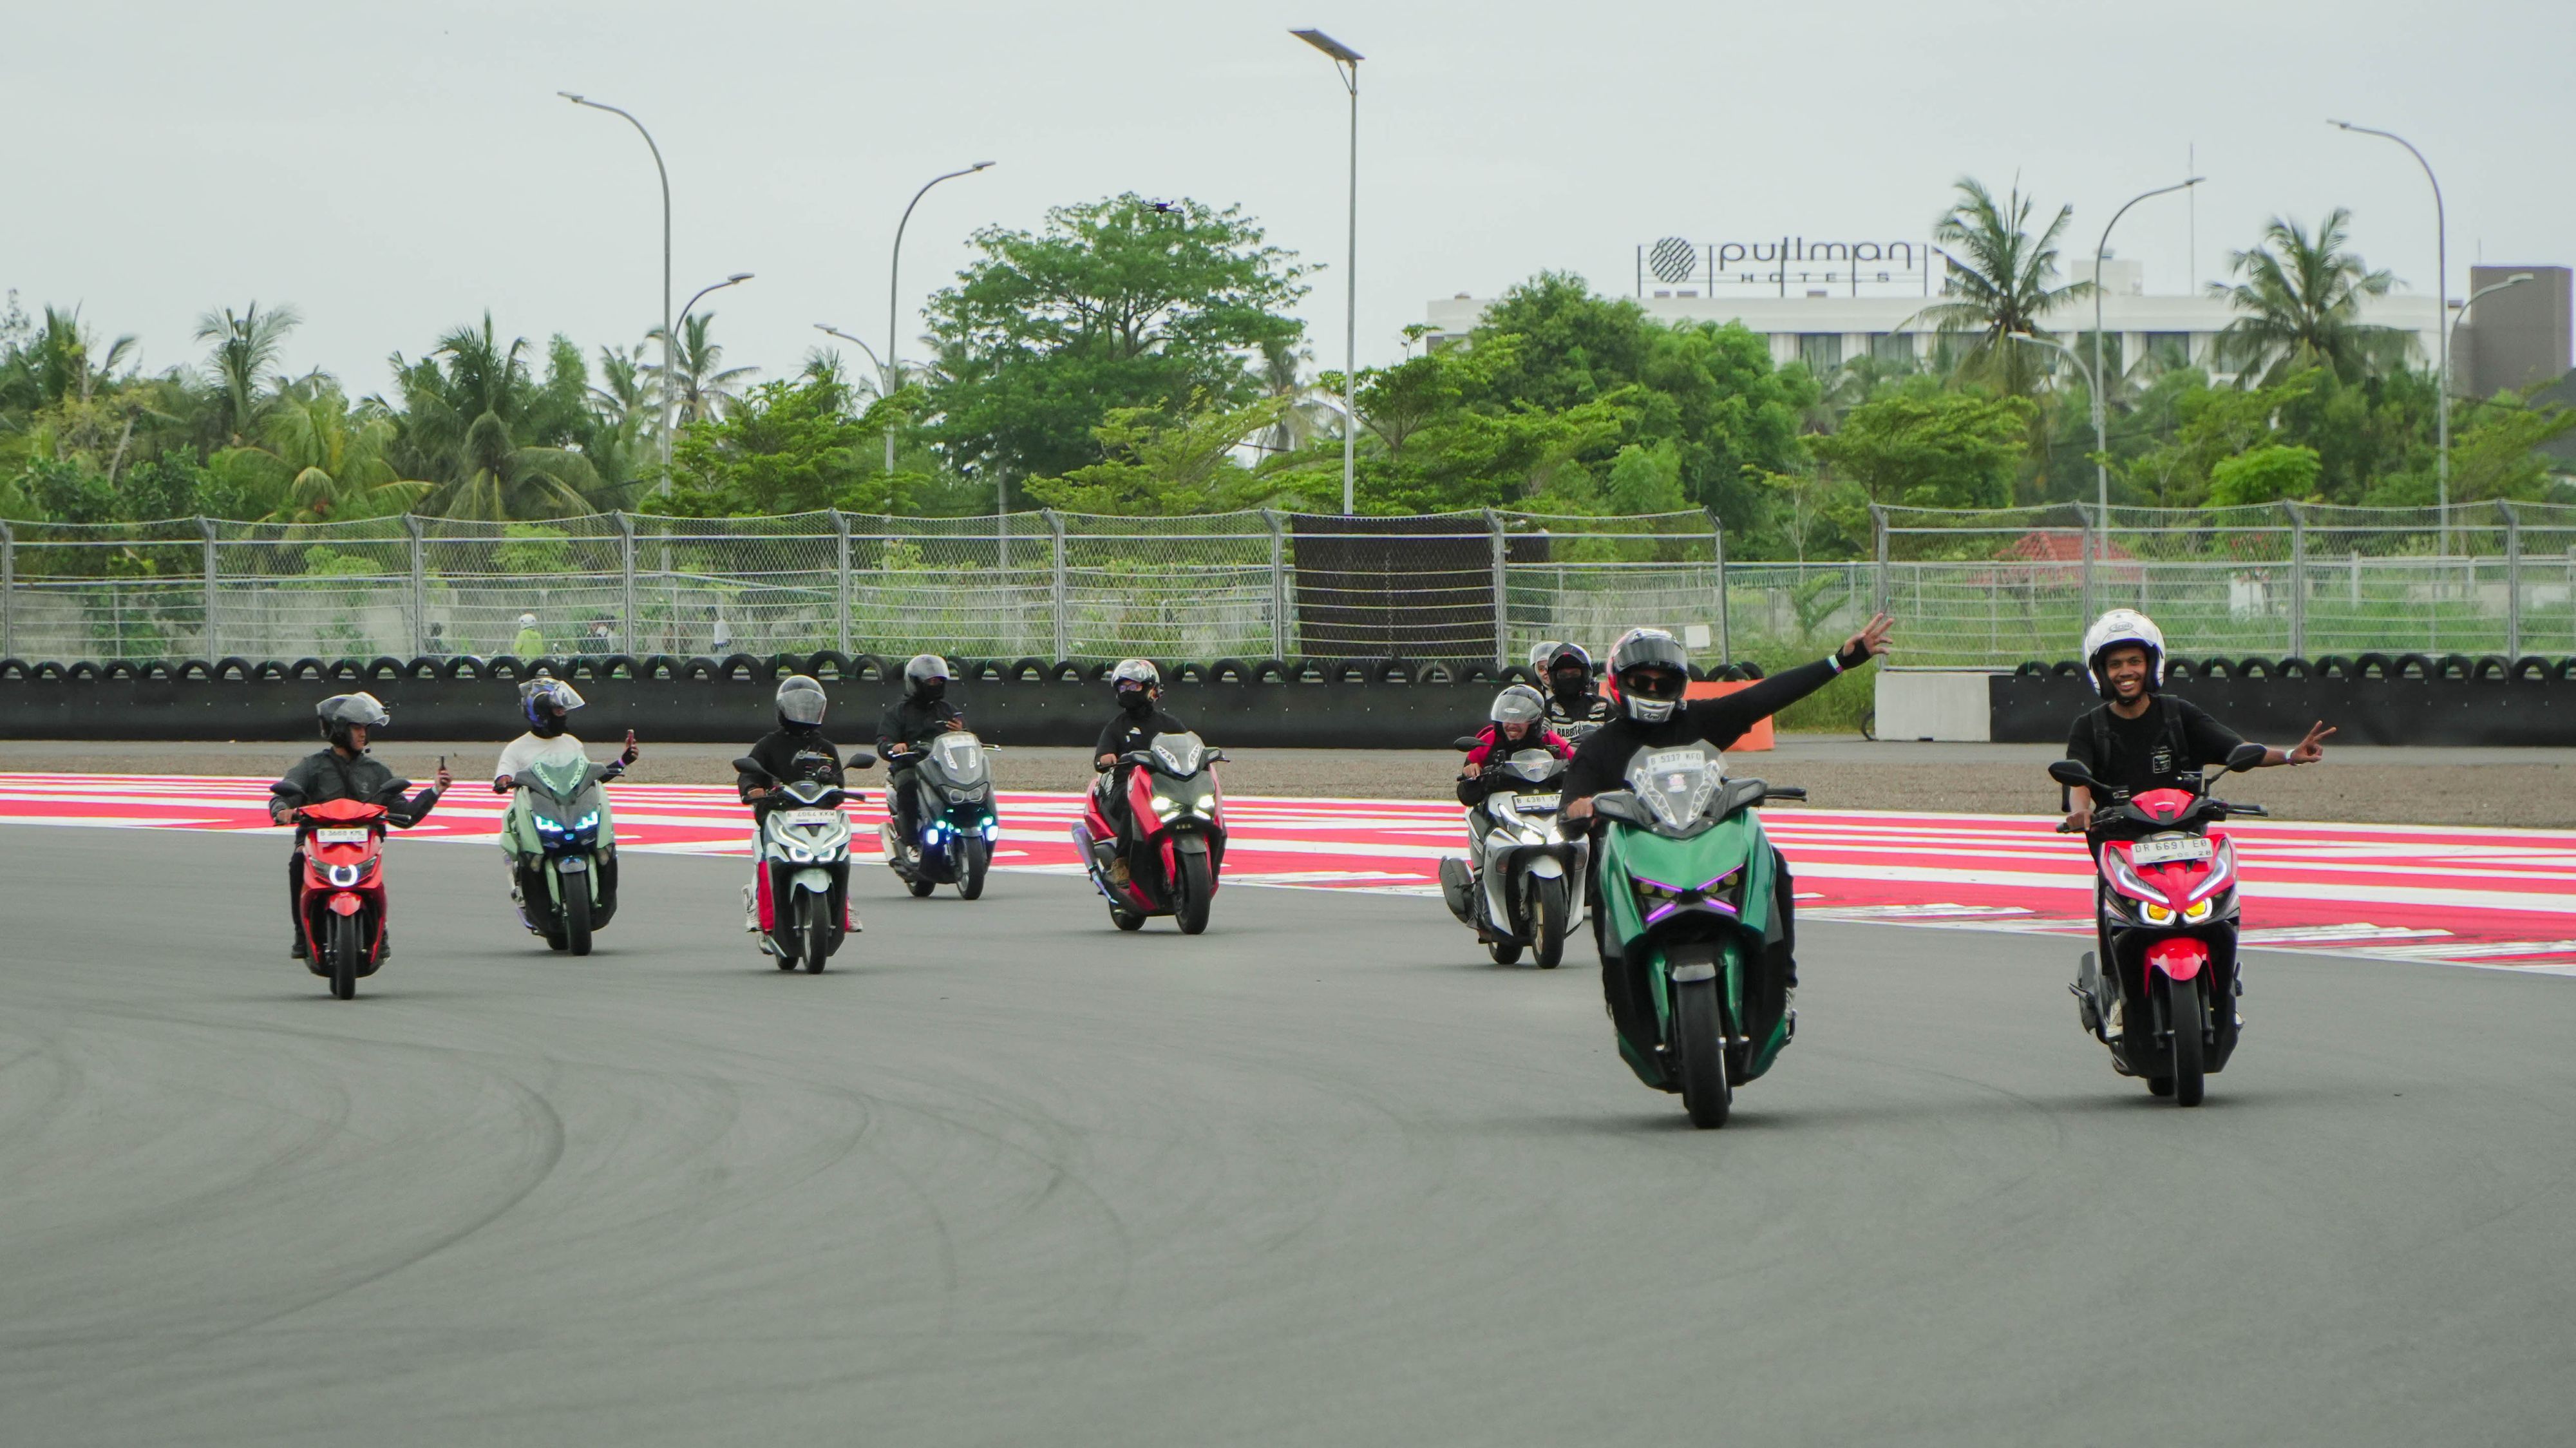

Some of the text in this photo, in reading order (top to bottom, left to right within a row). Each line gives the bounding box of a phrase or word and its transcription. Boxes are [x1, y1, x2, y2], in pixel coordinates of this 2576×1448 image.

[1719, 236, 1911, 271] pullman
[1741, 273, 1889, 283] HOTELS
[2135, 844, 2150, 852] DR
[2155, 841, 2184, 850] 6691
